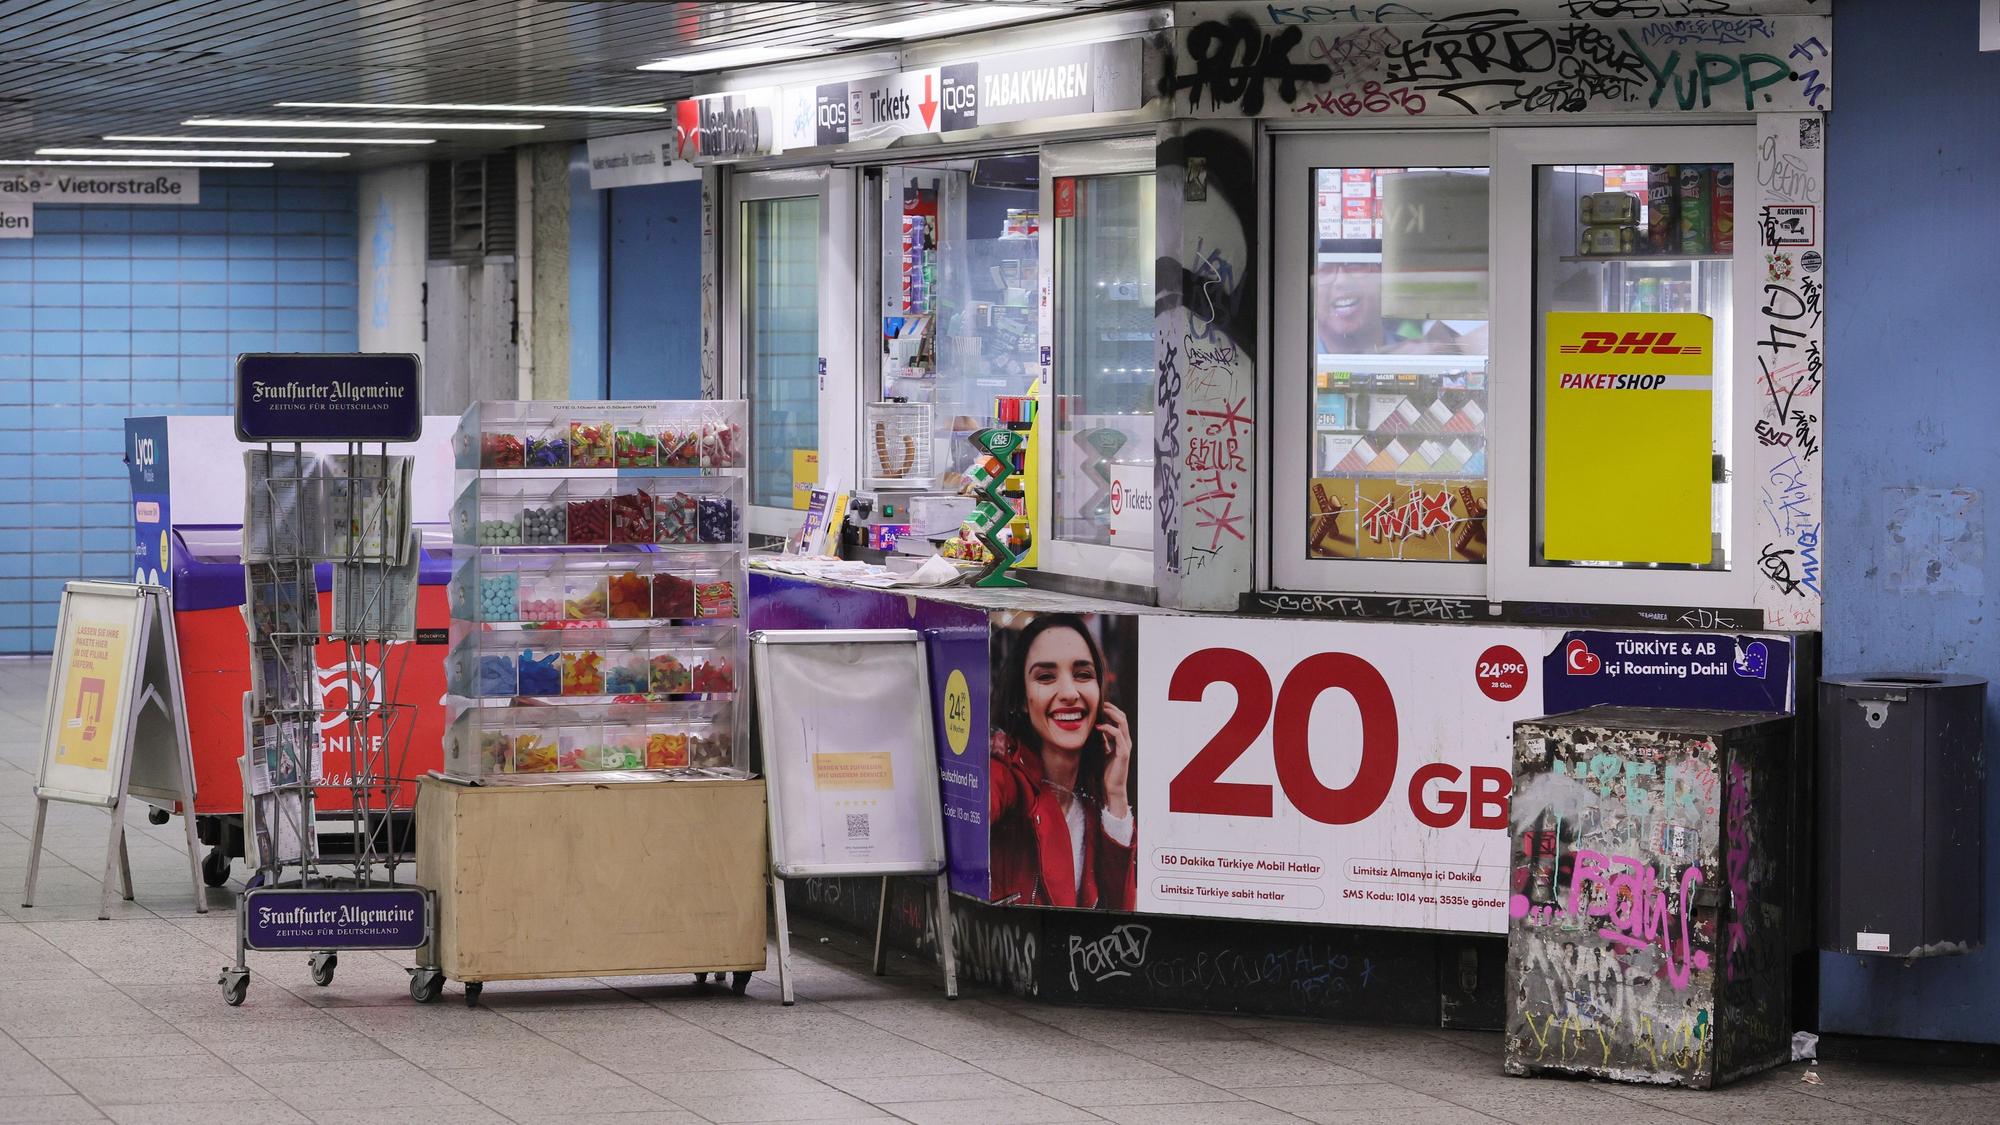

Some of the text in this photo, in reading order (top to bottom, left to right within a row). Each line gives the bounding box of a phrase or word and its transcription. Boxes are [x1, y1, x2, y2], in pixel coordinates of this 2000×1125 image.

[984, 62, 1087, 107] TABAKWAREN
[870, 88, 910, 123] Tickets
[943, 84, 975, 113] IQOS
[818, 102, 846, 129] IQOS
[58, 177, 182, 195] Vietorstraße
[1579, 332, 1682, 354] DHL
[1560, 373, 1666, 390] PAKETSHOP
[252, 380, 405, 403] Frankfurter Allgemeine
[269, 403, 306, 411] ZEITUNG
[309, 402, 326, 410] FÜR
[135, 432, 154, 472] Lyca
[1124, 488, 1152, 510] Tickets
[1616, 640, 1716, 655] TÜRKİYE & AB
[1479, 662, 1525, 678] 24,99€
[1605, 661, 1728, 678] içi Roaming Dahil
[1168, 648, 1399, 825] 20
[968, 774, 978, 789] Flat
[1408, 762, 1513, 830] GB
[1161, 855, 1321, 873] 150 Dakika Türkiye Mobil Hatlar
[1353, 866, 1481, 882] Limitsiz Almanya içi Dakika
[1160, 884, 1285, 900] Limitsiz Türkiye sabit hatlar
[1343, 889, 1506, 908] SMS Kodu: 1014 yaz, 3535'e gönder
[258, 905, 415, 928] Frankfurter Allgemeine
[276, 929, 314, 937] ZEITUNG
